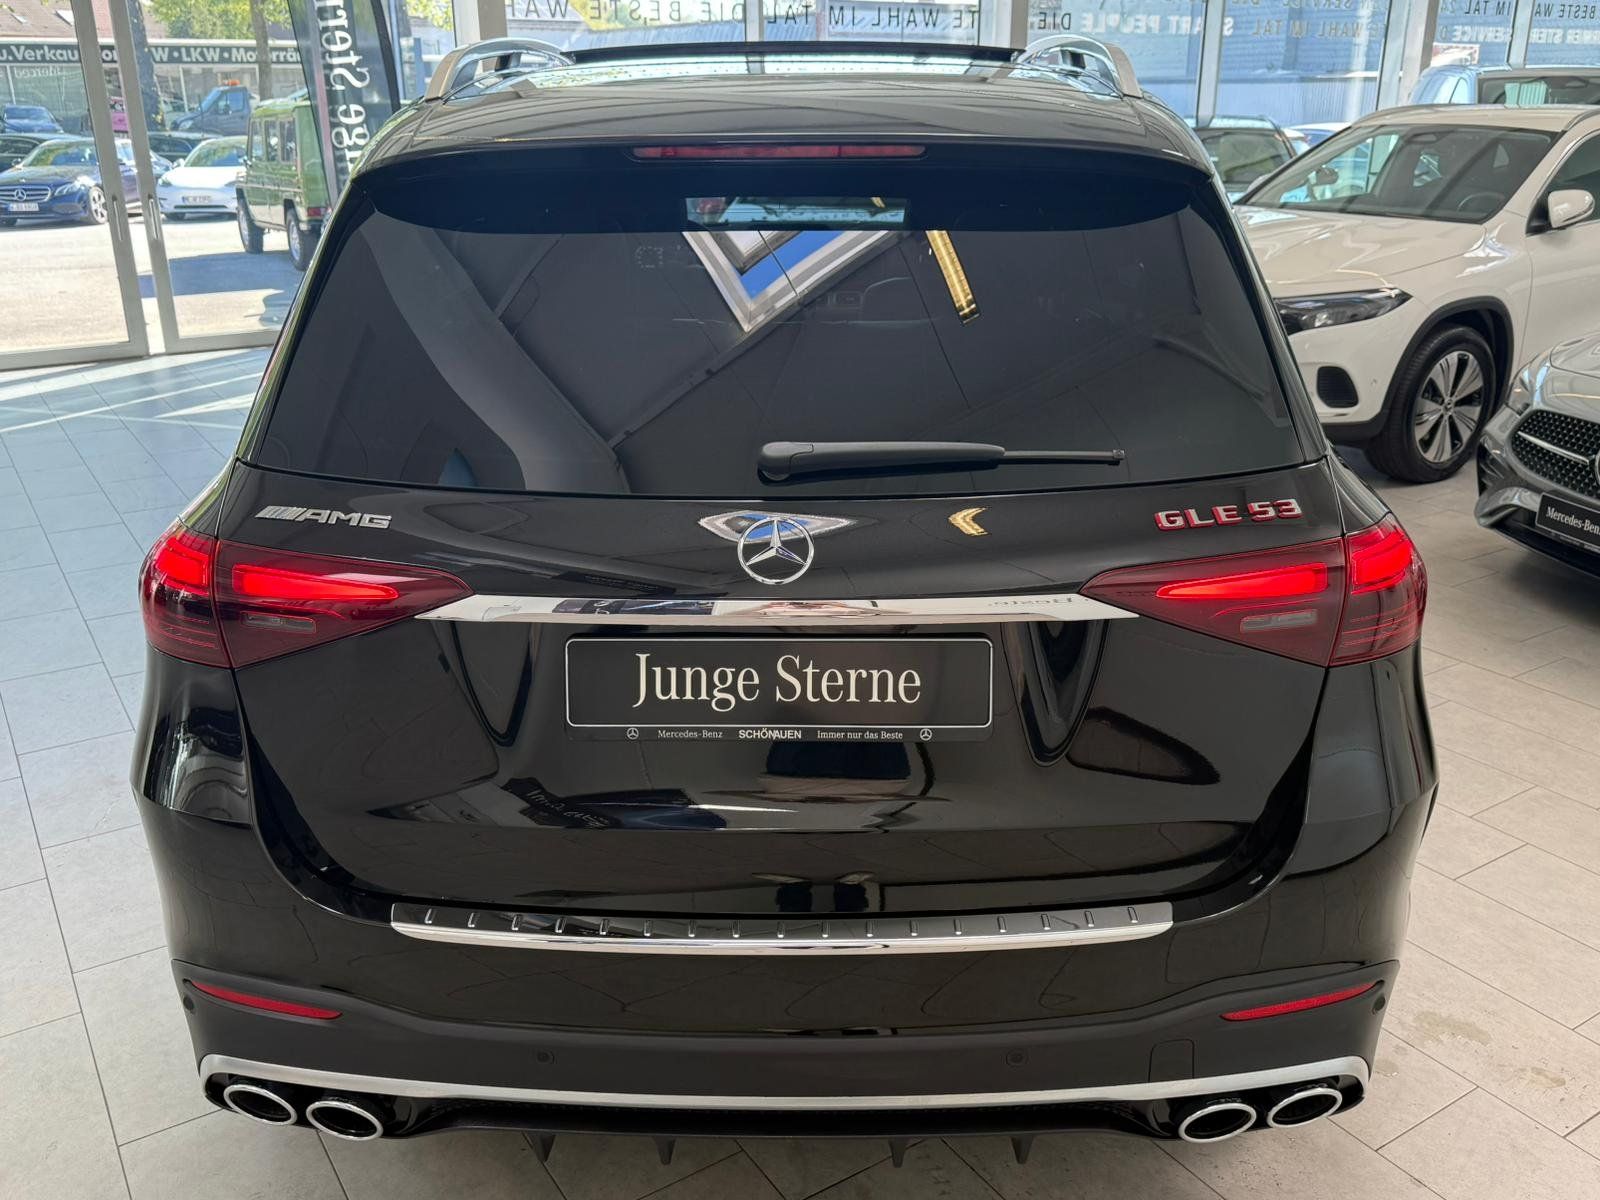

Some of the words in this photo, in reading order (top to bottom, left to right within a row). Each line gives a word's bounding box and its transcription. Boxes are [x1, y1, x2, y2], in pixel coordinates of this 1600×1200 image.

[182, 47, 220, 62] LKW
[295, 508, 392, 529] AMG
[1154, 505, 1243, 531] GLE
[1247, 498, 1303, 522] 53
[1546, 506, 1600, 535] Mercedes-Ben
[632, 653, 760, 712] Junge
[775, 654, 922, 704] Sterne
[657, 730, 723, 739] Mercedes-Benz
[817, 730, 846, 739] Immer
[864, 730, 880, 740] das
[881, 730, 903, 740] Beste
